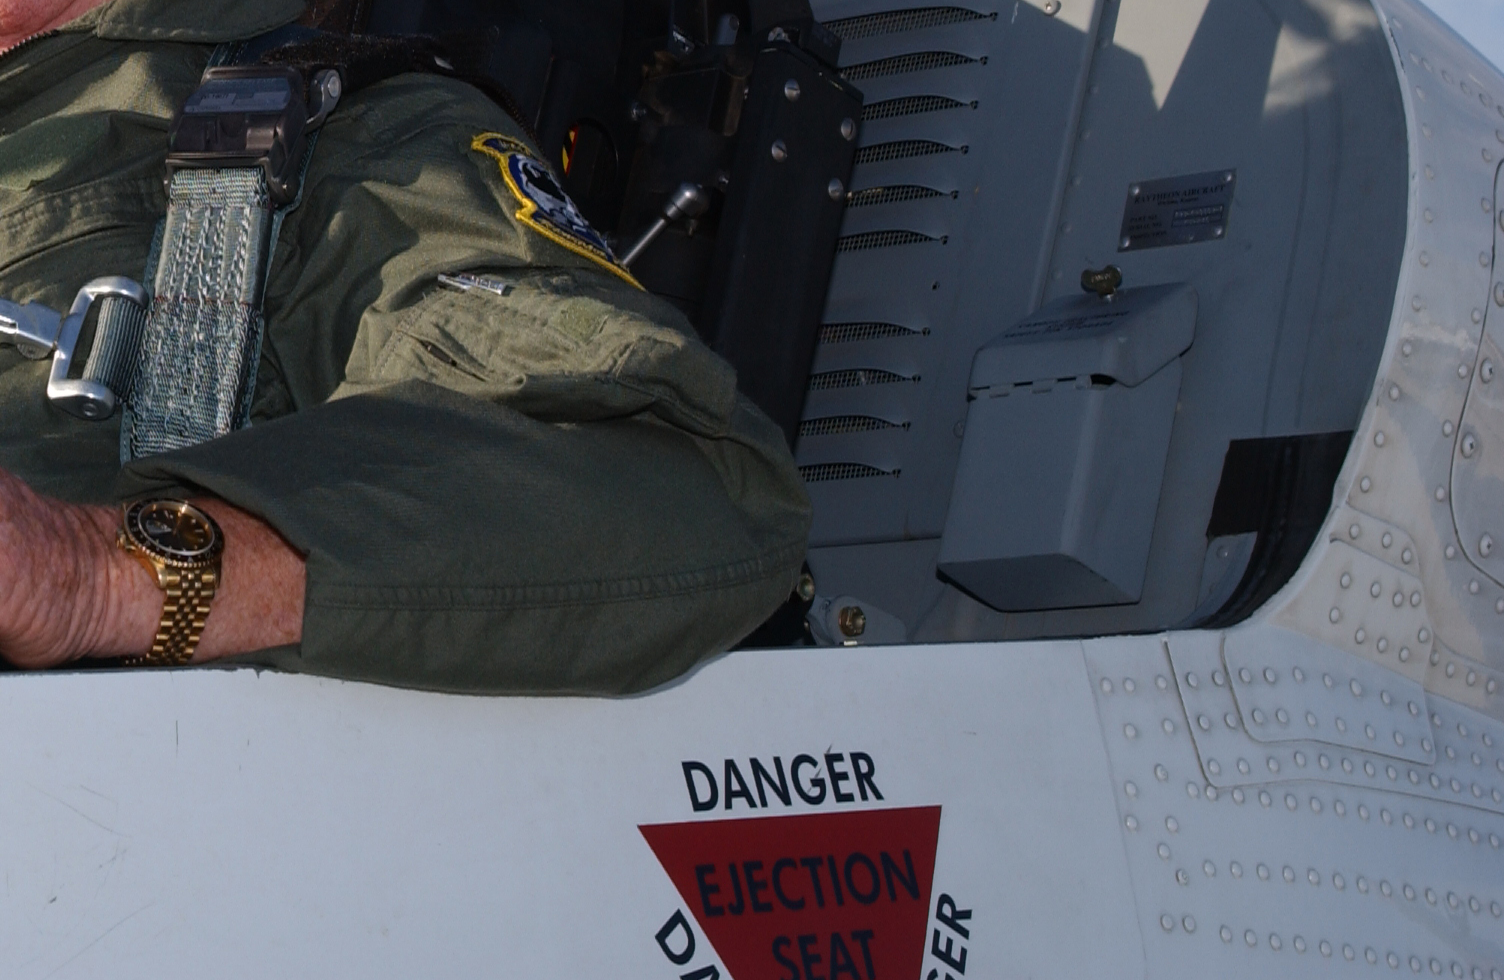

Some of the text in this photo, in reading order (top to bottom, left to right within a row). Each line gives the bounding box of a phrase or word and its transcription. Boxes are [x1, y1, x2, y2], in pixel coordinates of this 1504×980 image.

[1134, 184, 1226, 205] RAYTHEON AIRCRAFT
[681, 751, 885, 812] DANGER
[695, 849, 921, 918] EJECTION
[772, 929, 877, 980] SEAT
